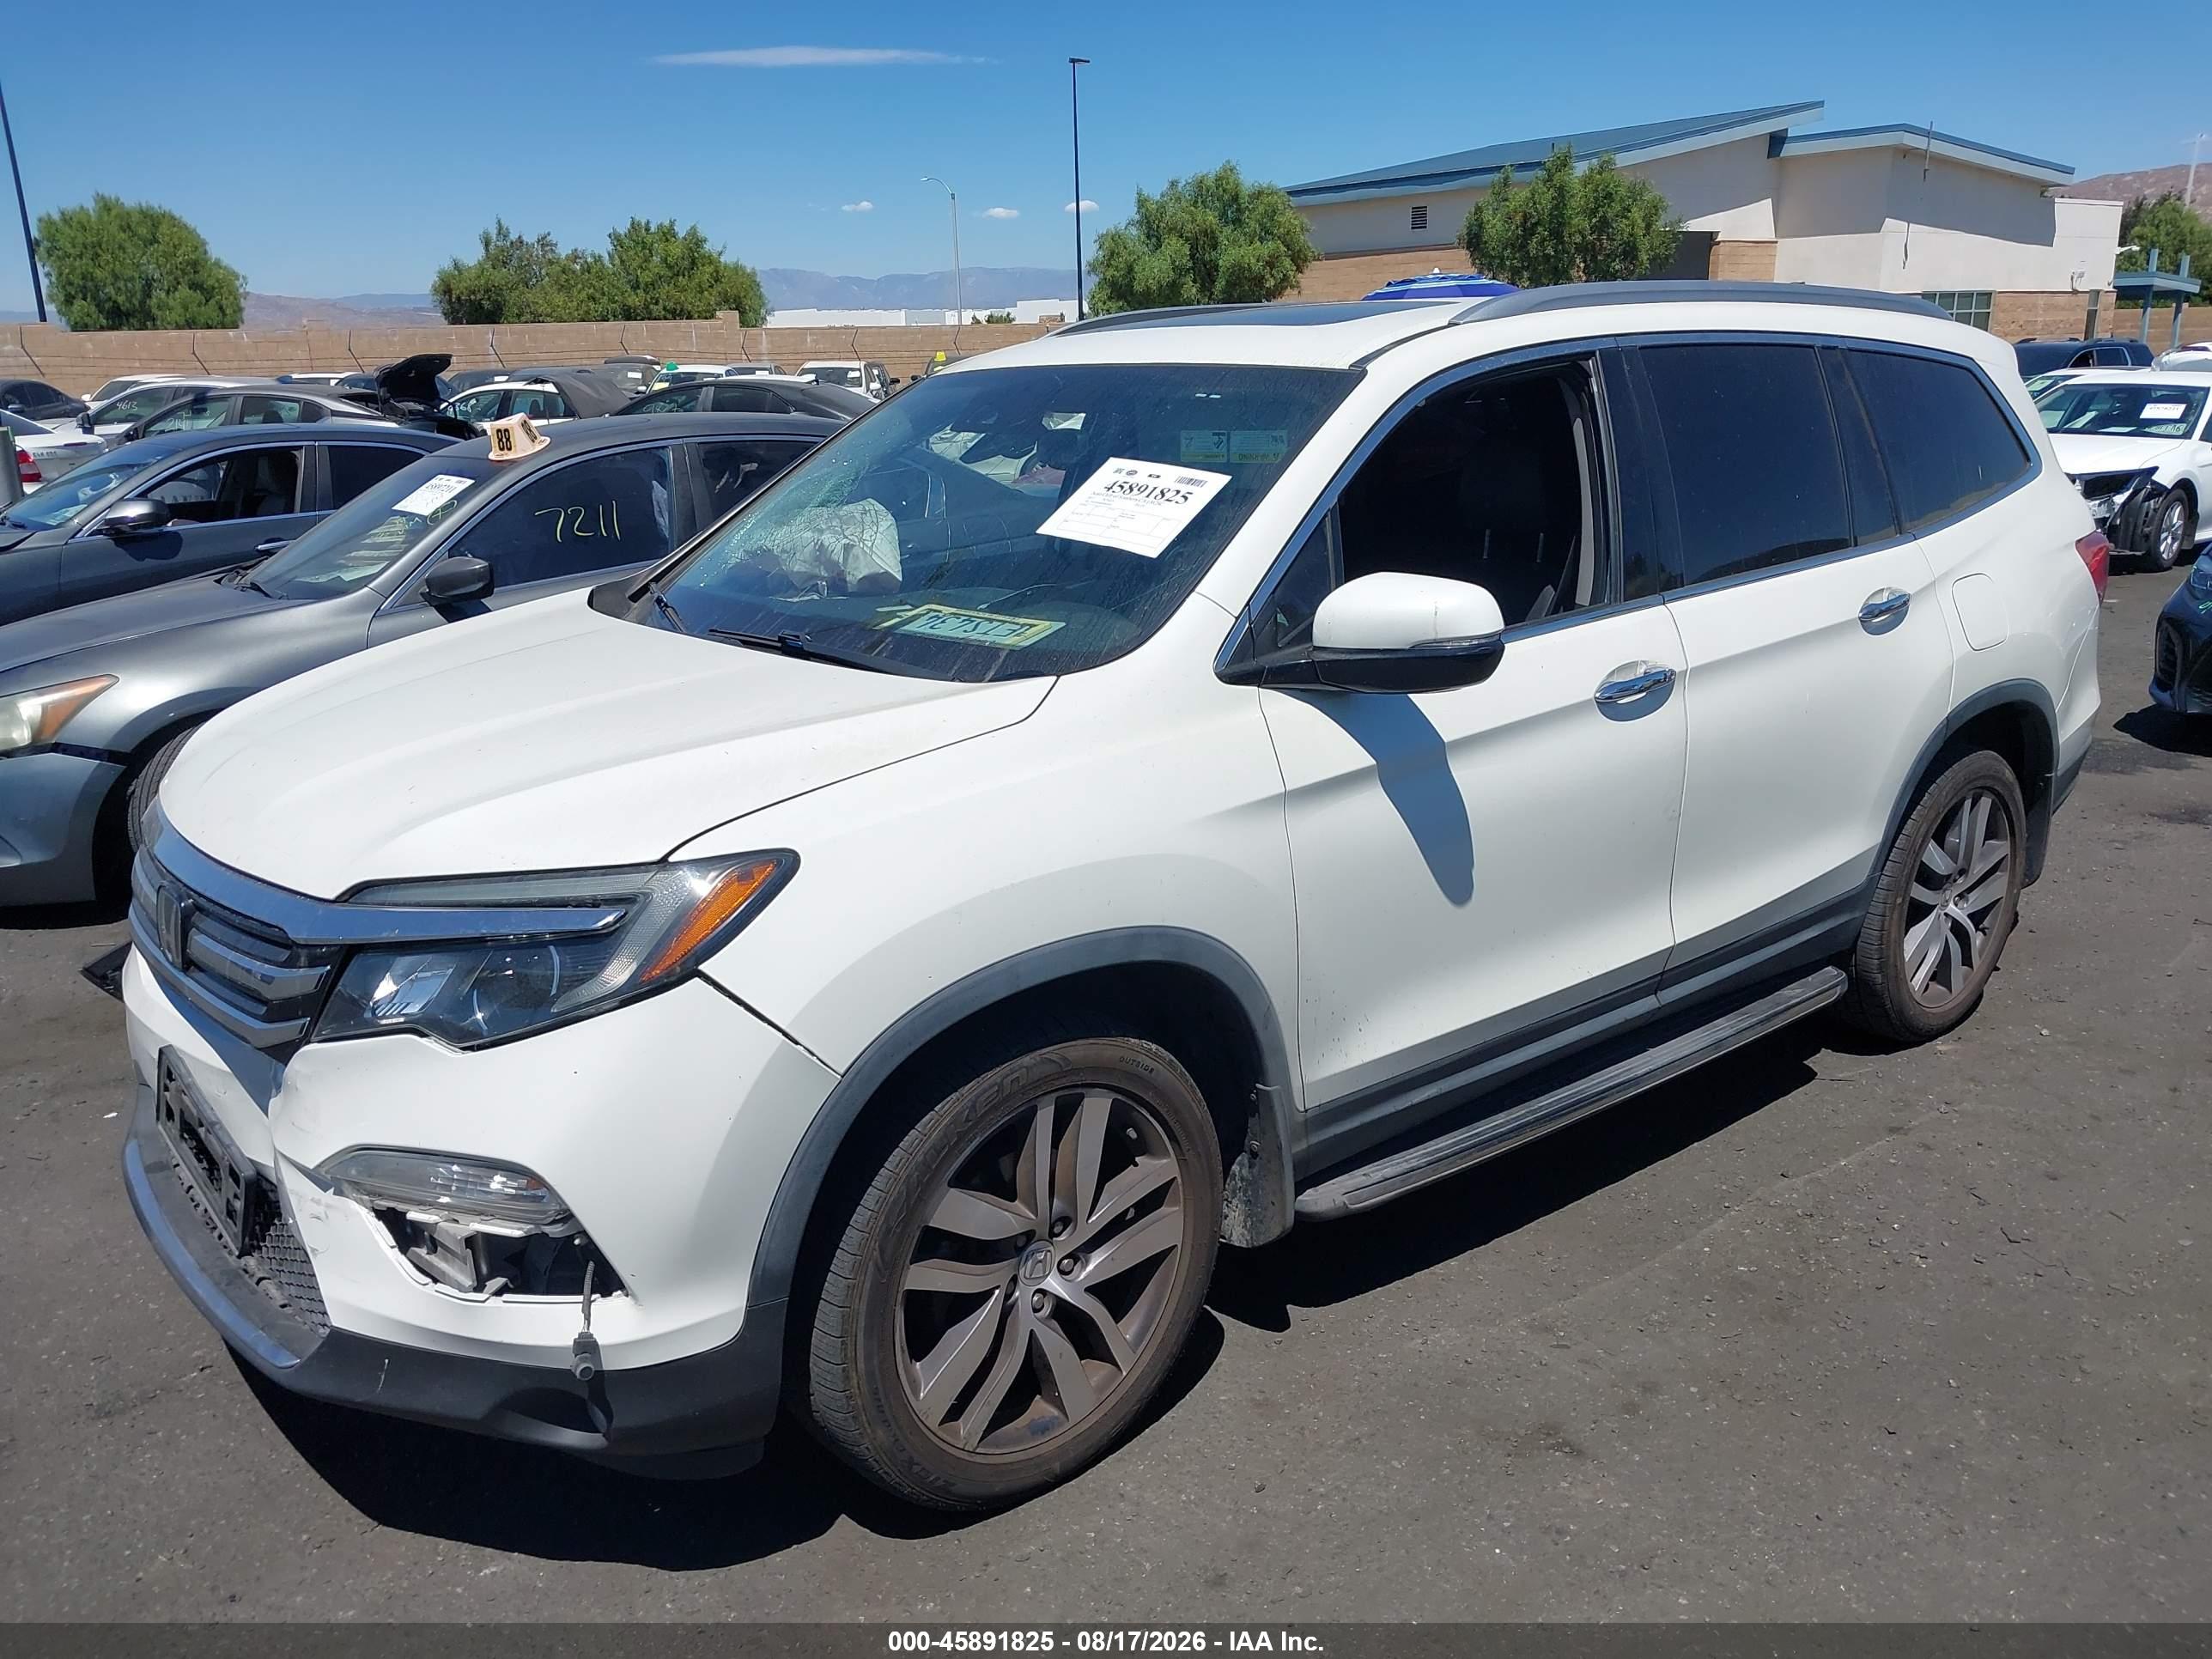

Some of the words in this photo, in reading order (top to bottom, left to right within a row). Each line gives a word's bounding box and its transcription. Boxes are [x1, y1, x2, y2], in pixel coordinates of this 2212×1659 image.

[116, 400, 138, 411] 4613
[495, 428, 512, 451] 88
[1103, 480, 1194, 505] 45891825
[535, 500, 621, 543] 7211
[1119, 1056, 1155, 1074] OUTSIDE
